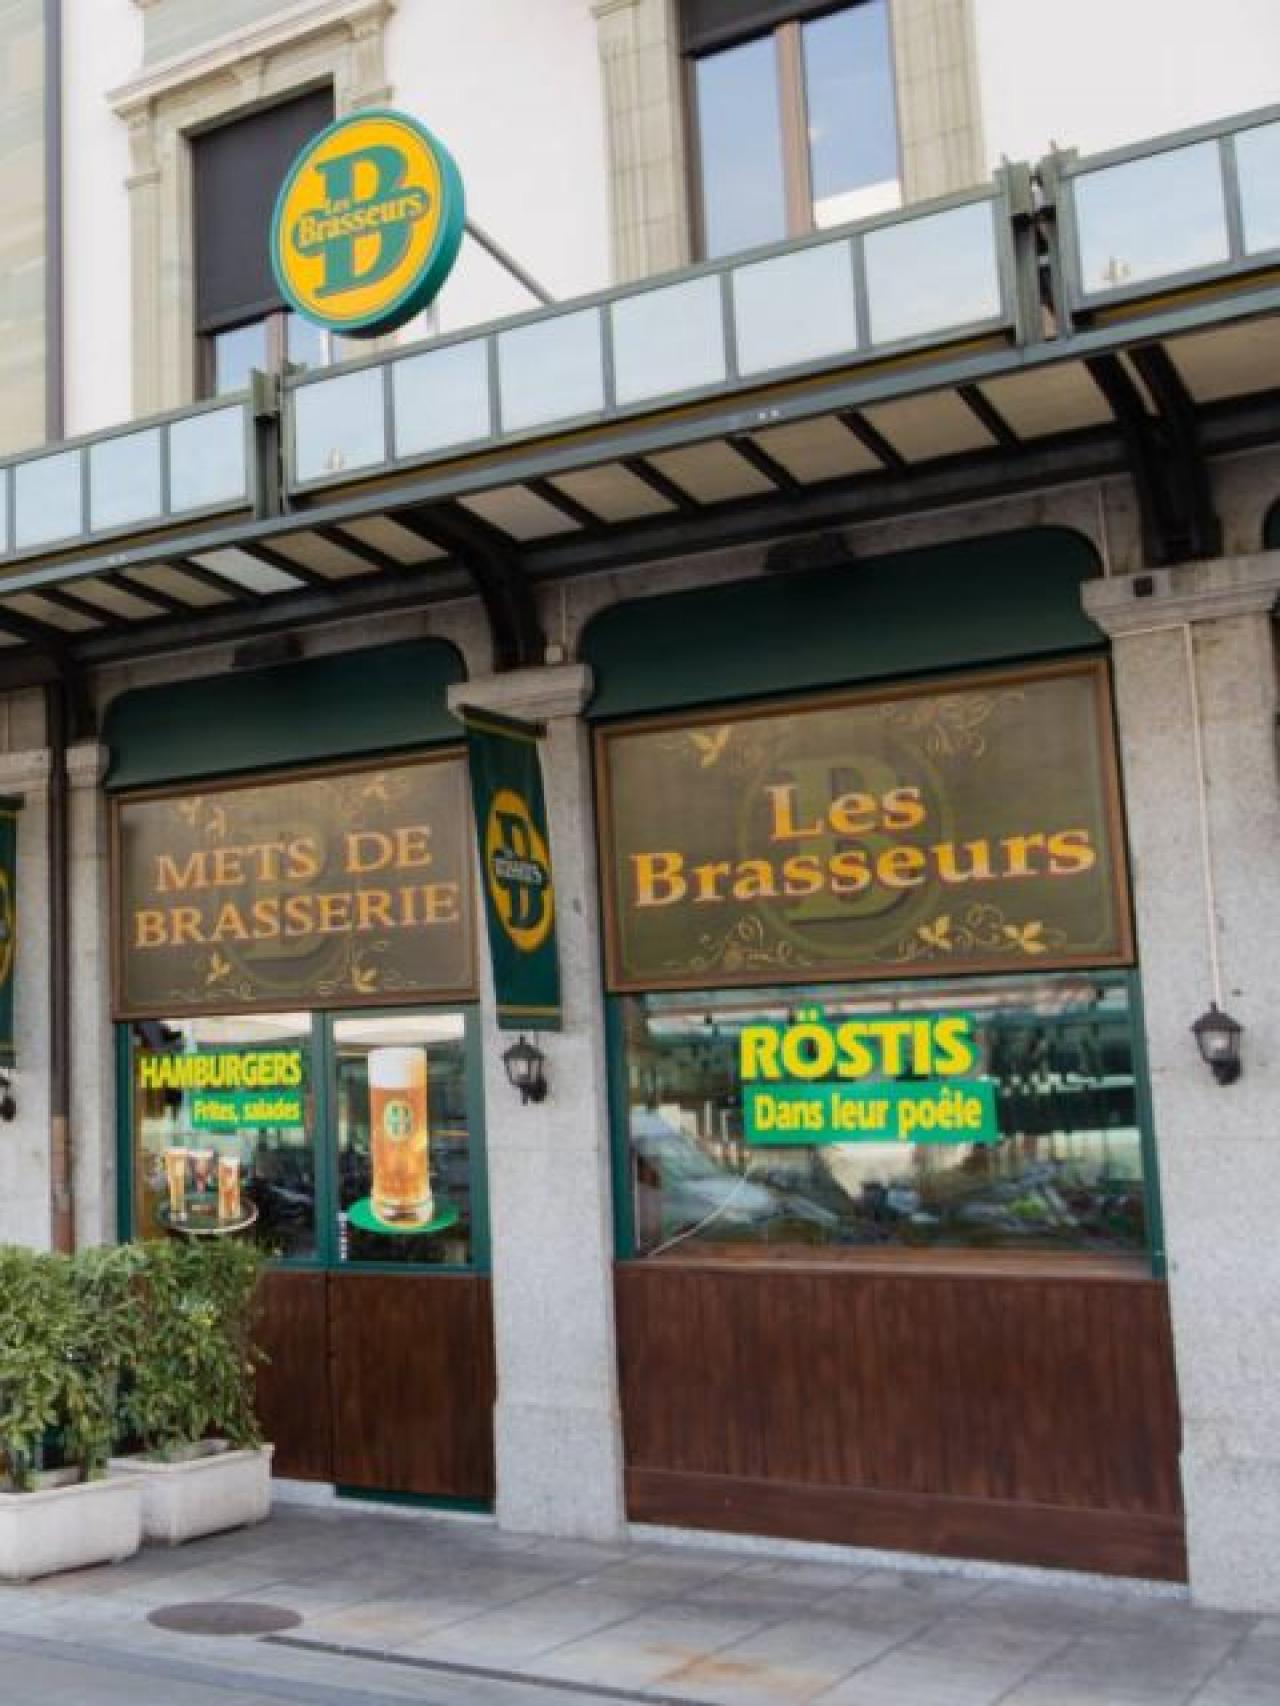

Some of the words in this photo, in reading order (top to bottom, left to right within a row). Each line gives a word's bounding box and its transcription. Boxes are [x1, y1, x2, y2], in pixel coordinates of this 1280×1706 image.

[297, 192, 424, 248] Brasseurs
[764, 783, 928, 843] Les
[154, 836, 320, 893] METS
[345, 825, 433, 873] DE
[629, 827, 1098, 909] Brasseurs
[134, 882, 460, 948] BRASSERIE
[140, 1052, 302, 1089] HAMBURGERS
[740, 1008, 973, 1080] RÖSTIS
[754, 1093, 824, 1131] Dans
[831, 1092, 888, 1130] leur
